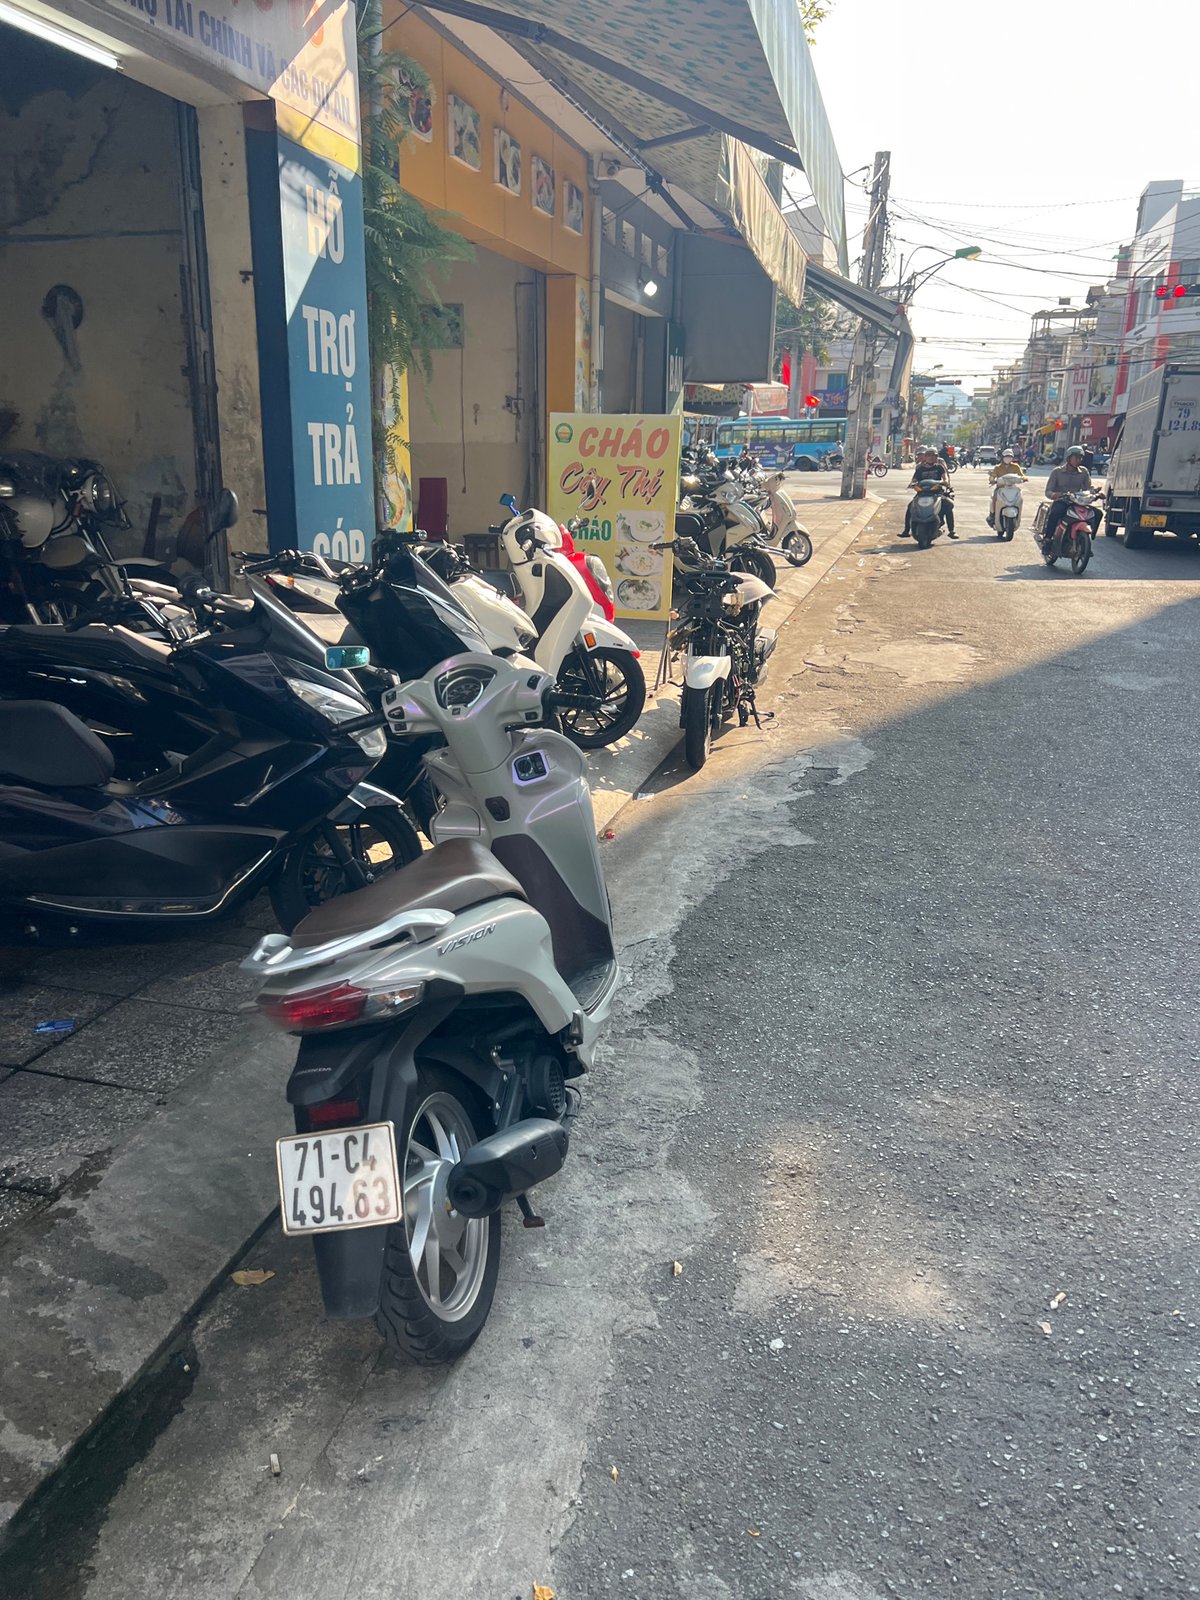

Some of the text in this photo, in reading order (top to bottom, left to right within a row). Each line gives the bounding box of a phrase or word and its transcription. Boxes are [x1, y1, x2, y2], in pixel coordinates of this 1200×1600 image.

[199, 10, 252, 70] CHÍNH
[256, 42, 277, 83] VÀ
[305, 169, 344, 265] HỖ
[302, 304, 356, 392] TRỢ
[1178, 408, 1191, 418] 79
[307, 406, 361, 486] TRẢ
[578, 419, 670, 459] CHÁO
[617, 464, 664, 505] Thị
[437, 923, 497, 957] VISION
[294, 1132, 378, 1182] 71-C4
[292, 1177, 390, 1226] 494.63
